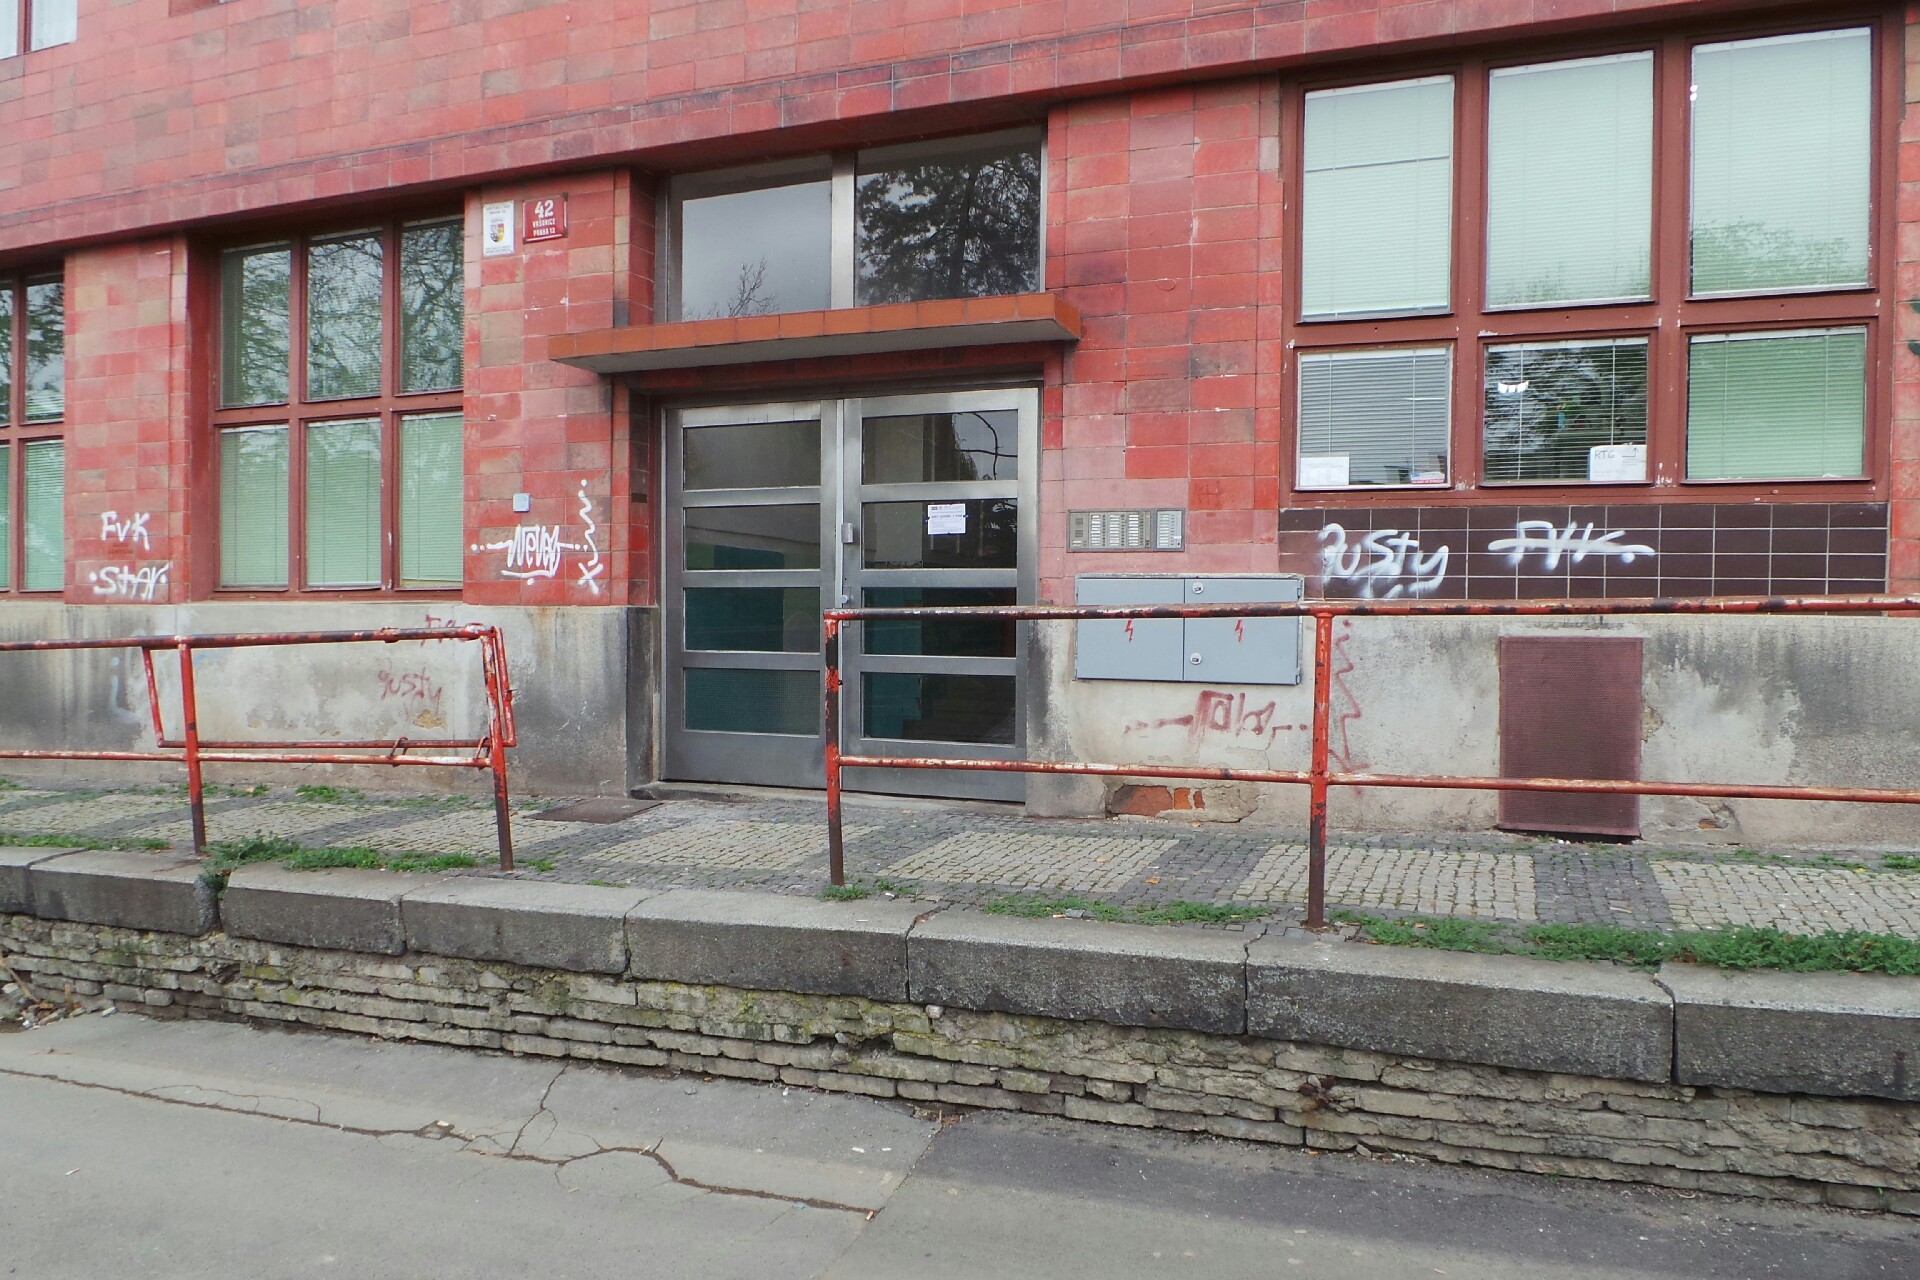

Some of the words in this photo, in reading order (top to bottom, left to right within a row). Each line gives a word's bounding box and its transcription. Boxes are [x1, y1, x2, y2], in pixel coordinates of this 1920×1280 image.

[534, 199, 554, 218] 42
[532, 218, 555, 228] VRŠOVICE
[533, 228, 549, 237] PRAHA
